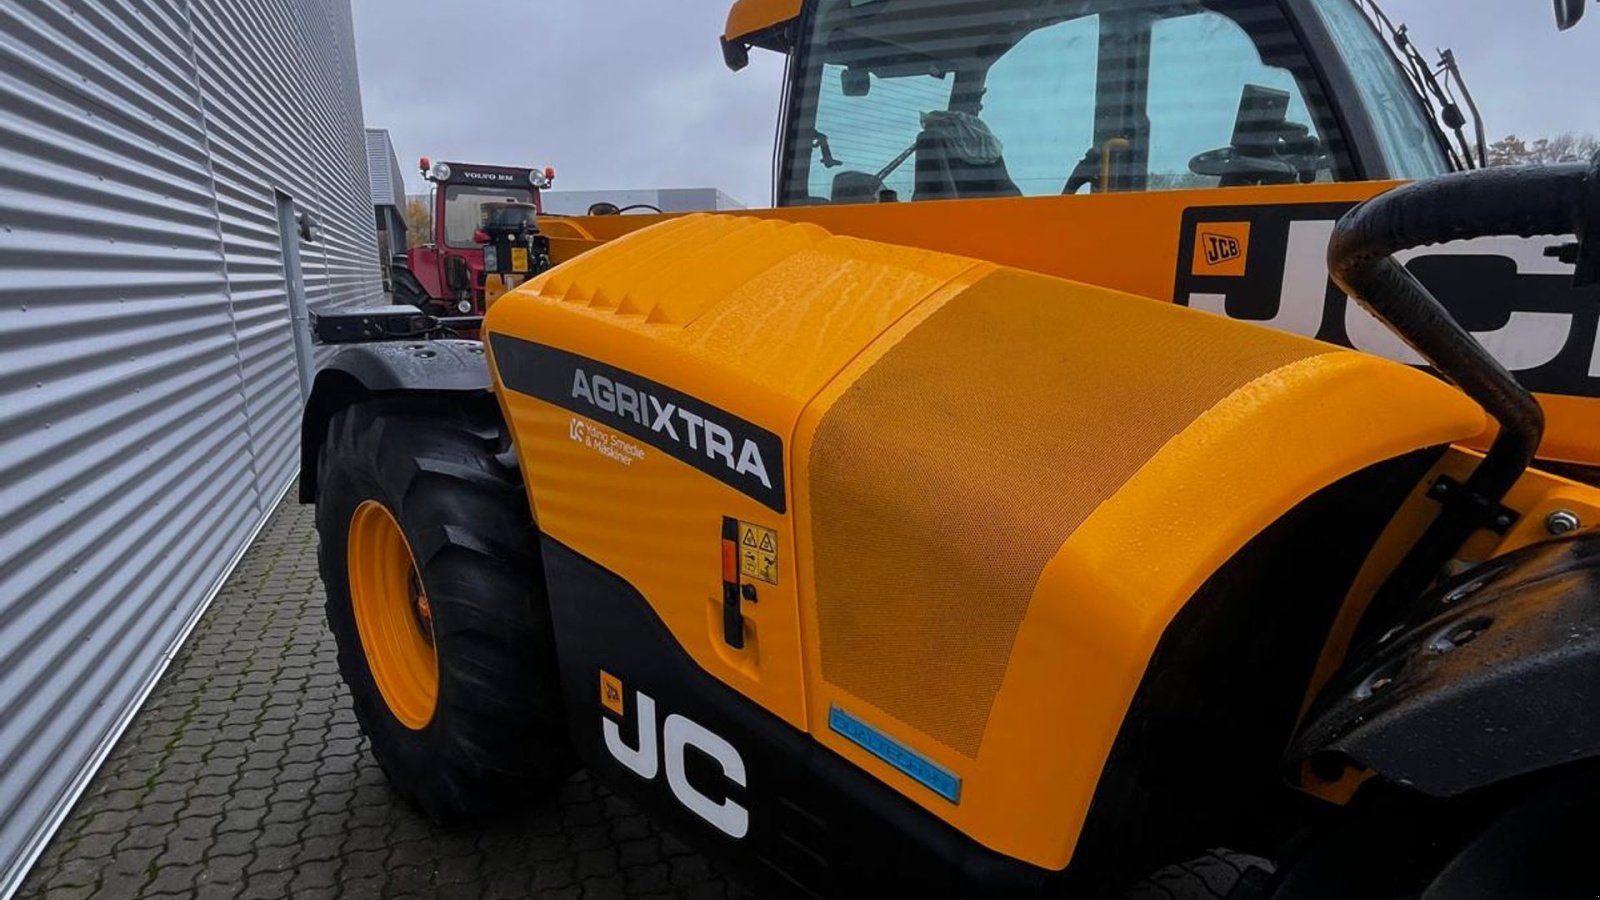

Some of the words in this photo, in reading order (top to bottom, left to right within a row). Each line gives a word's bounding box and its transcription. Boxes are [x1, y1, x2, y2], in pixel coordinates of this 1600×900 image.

[464, 172, 496, 181] VOLVO
[1207, 236, 1239, 262] JCB
[1188, 219, 1600, 378] JC
[572, 368, 773, 489] AGRIXTRA
[585, 423, 609, 445] Yding
[610, 434, 646, 461] Smedie
[585, 435, 593, 447] &
[593, 438, 633, 466] Maskiner
[602, 690, 749, 839] JC
